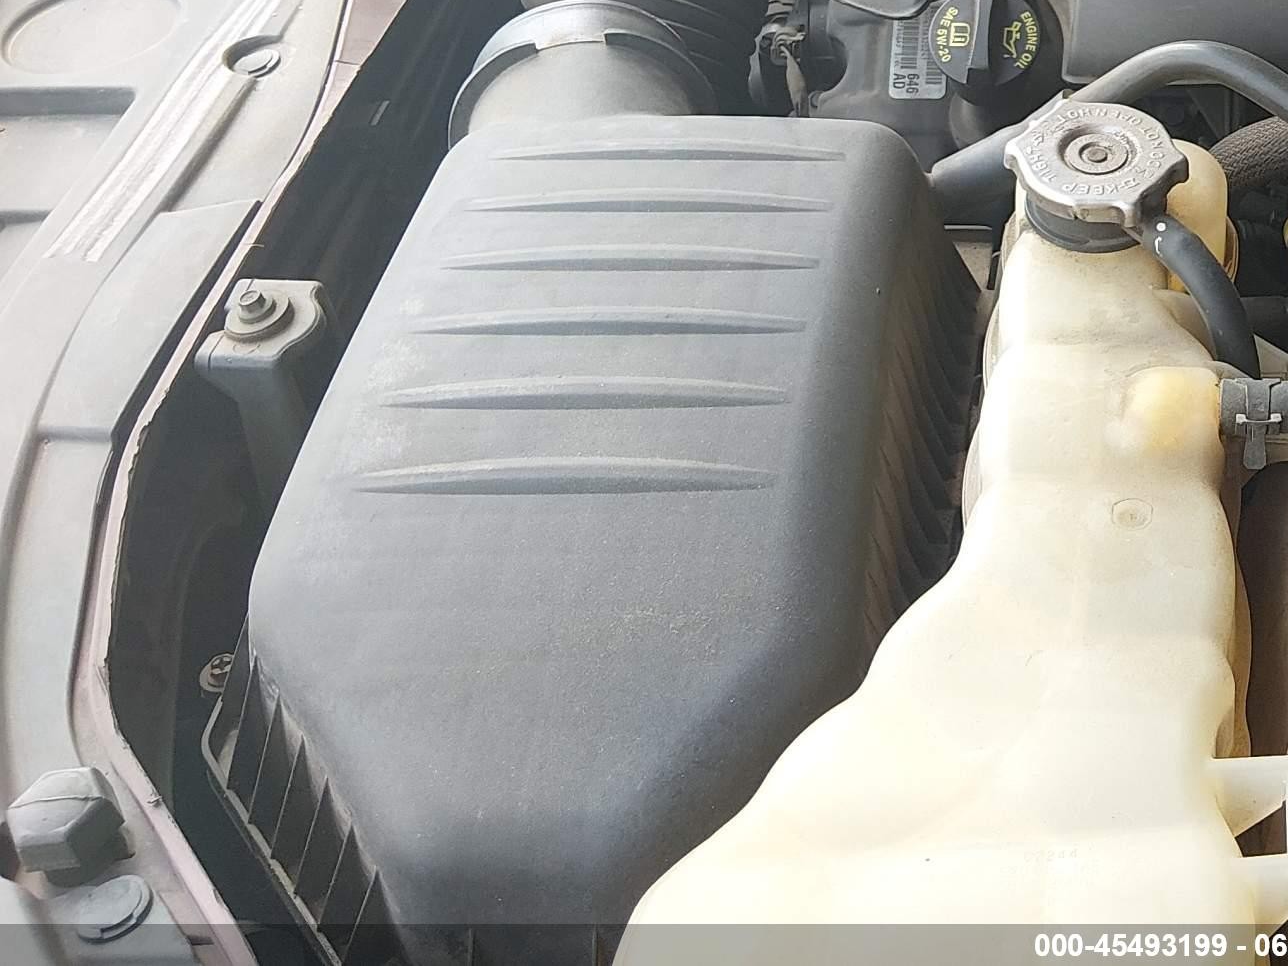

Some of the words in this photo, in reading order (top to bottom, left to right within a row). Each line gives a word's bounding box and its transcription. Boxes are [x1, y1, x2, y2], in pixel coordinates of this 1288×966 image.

[939, 6, 959, 27] SAE
[1020, 11, 1039, 54] ENGINE
[935, 29, 952, 63] 5W-20
[1013, 53, 1033, 69] OIL
[892, 73, 907, 90] AD
[906, 72, 920, 94] 646
[1061, 182, 1120, 196] KEEP
